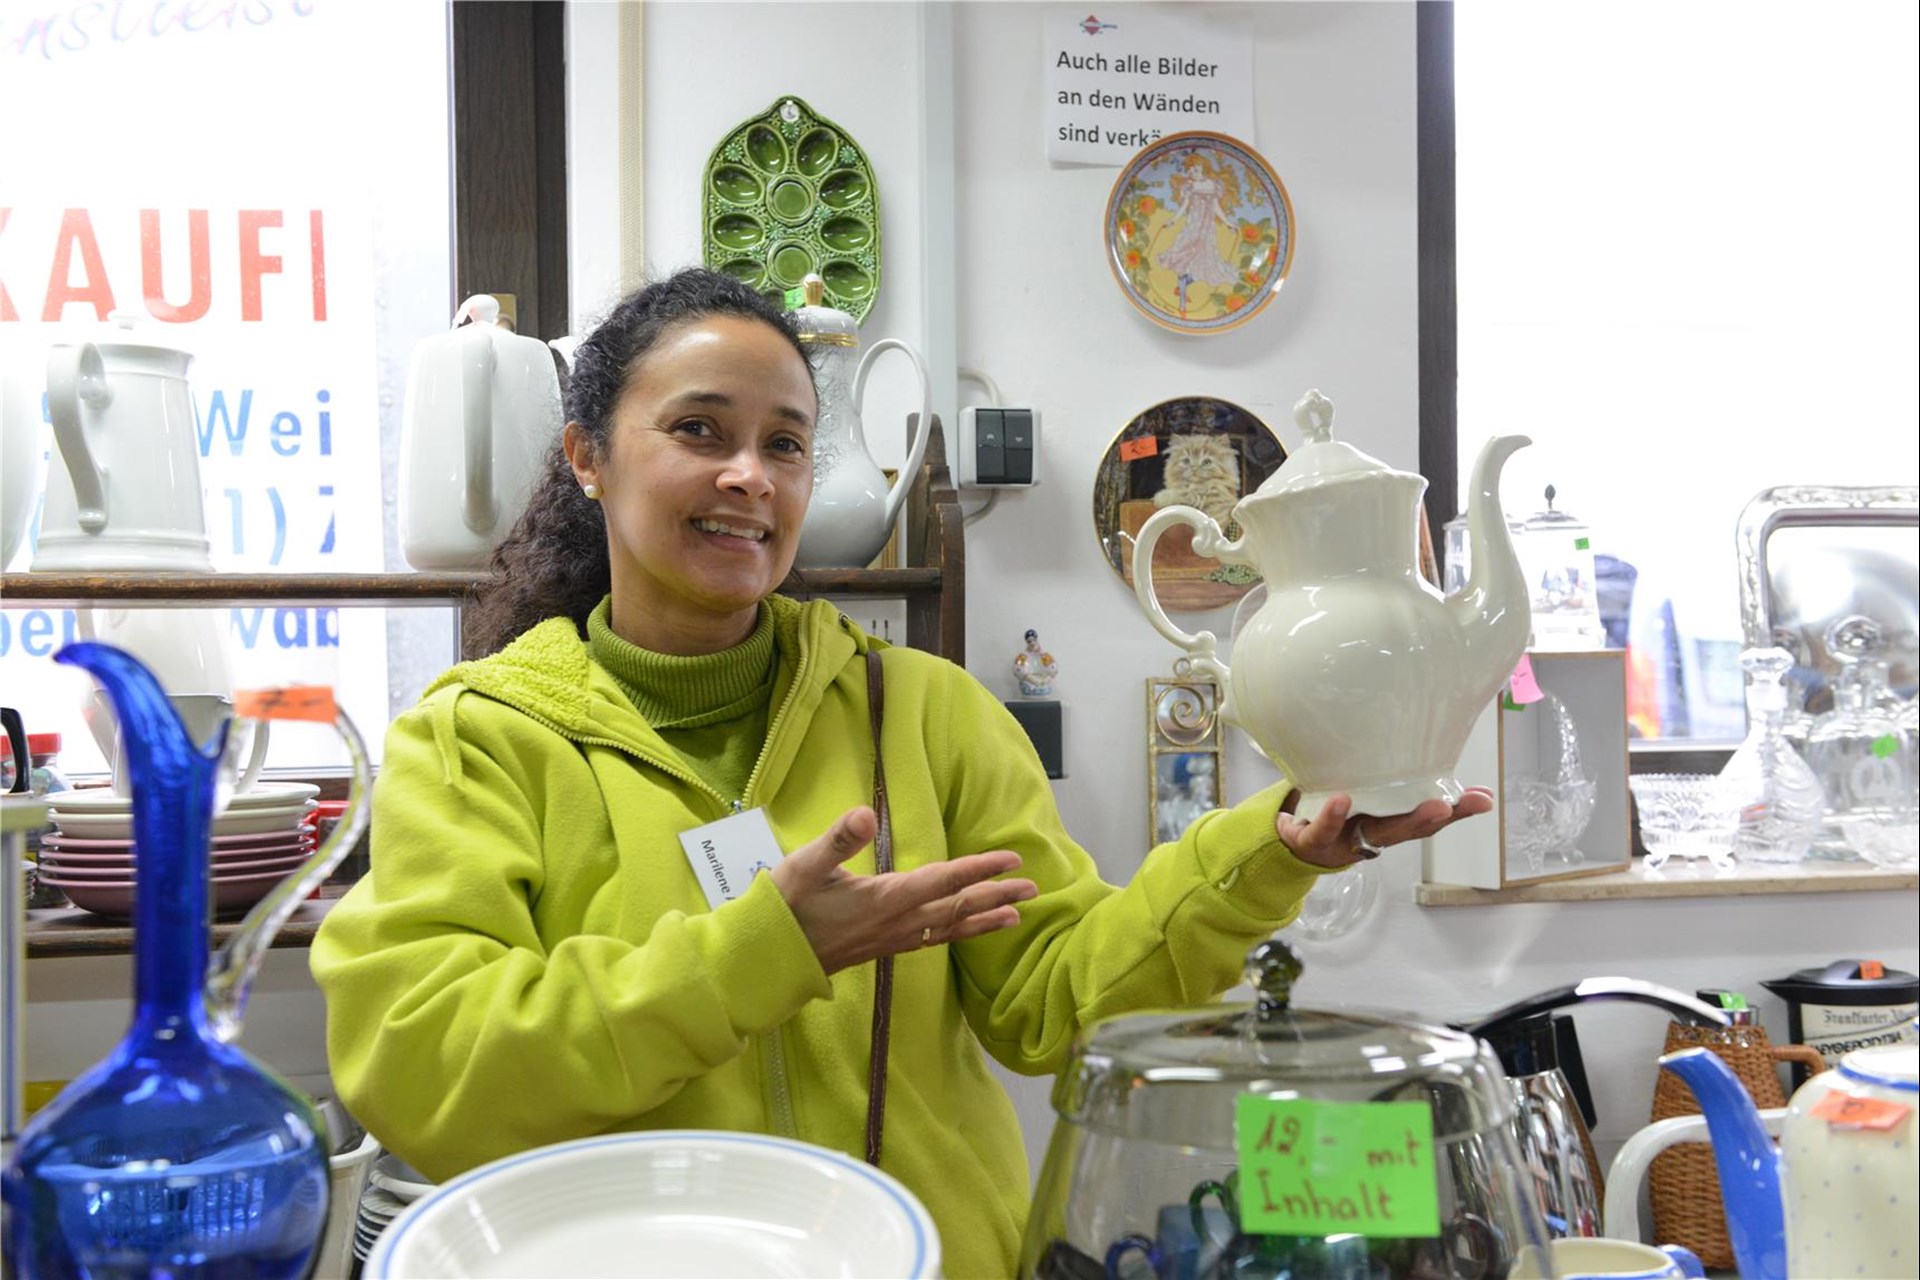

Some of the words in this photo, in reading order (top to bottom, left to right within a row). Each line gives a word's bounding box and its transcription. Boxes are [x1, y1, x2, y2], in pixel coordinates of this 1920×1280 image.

[1057, 51, 1108, 71] Auch
[1115, 55, 1151, 74] alle
[1158, 57, 1218, 78] Bilder
[1058, 90, 1082, 106] an
[1089, 89, 1126, 109] den
[1133, 92, 1220, 114] Wänden
[1058, 123, 1099, 143] sind
[701, 839, 731, 894] Marilene
[1366, 1129, 1421, 1169] mit
[1257, 1168, 1394, 1221] Inhalt
